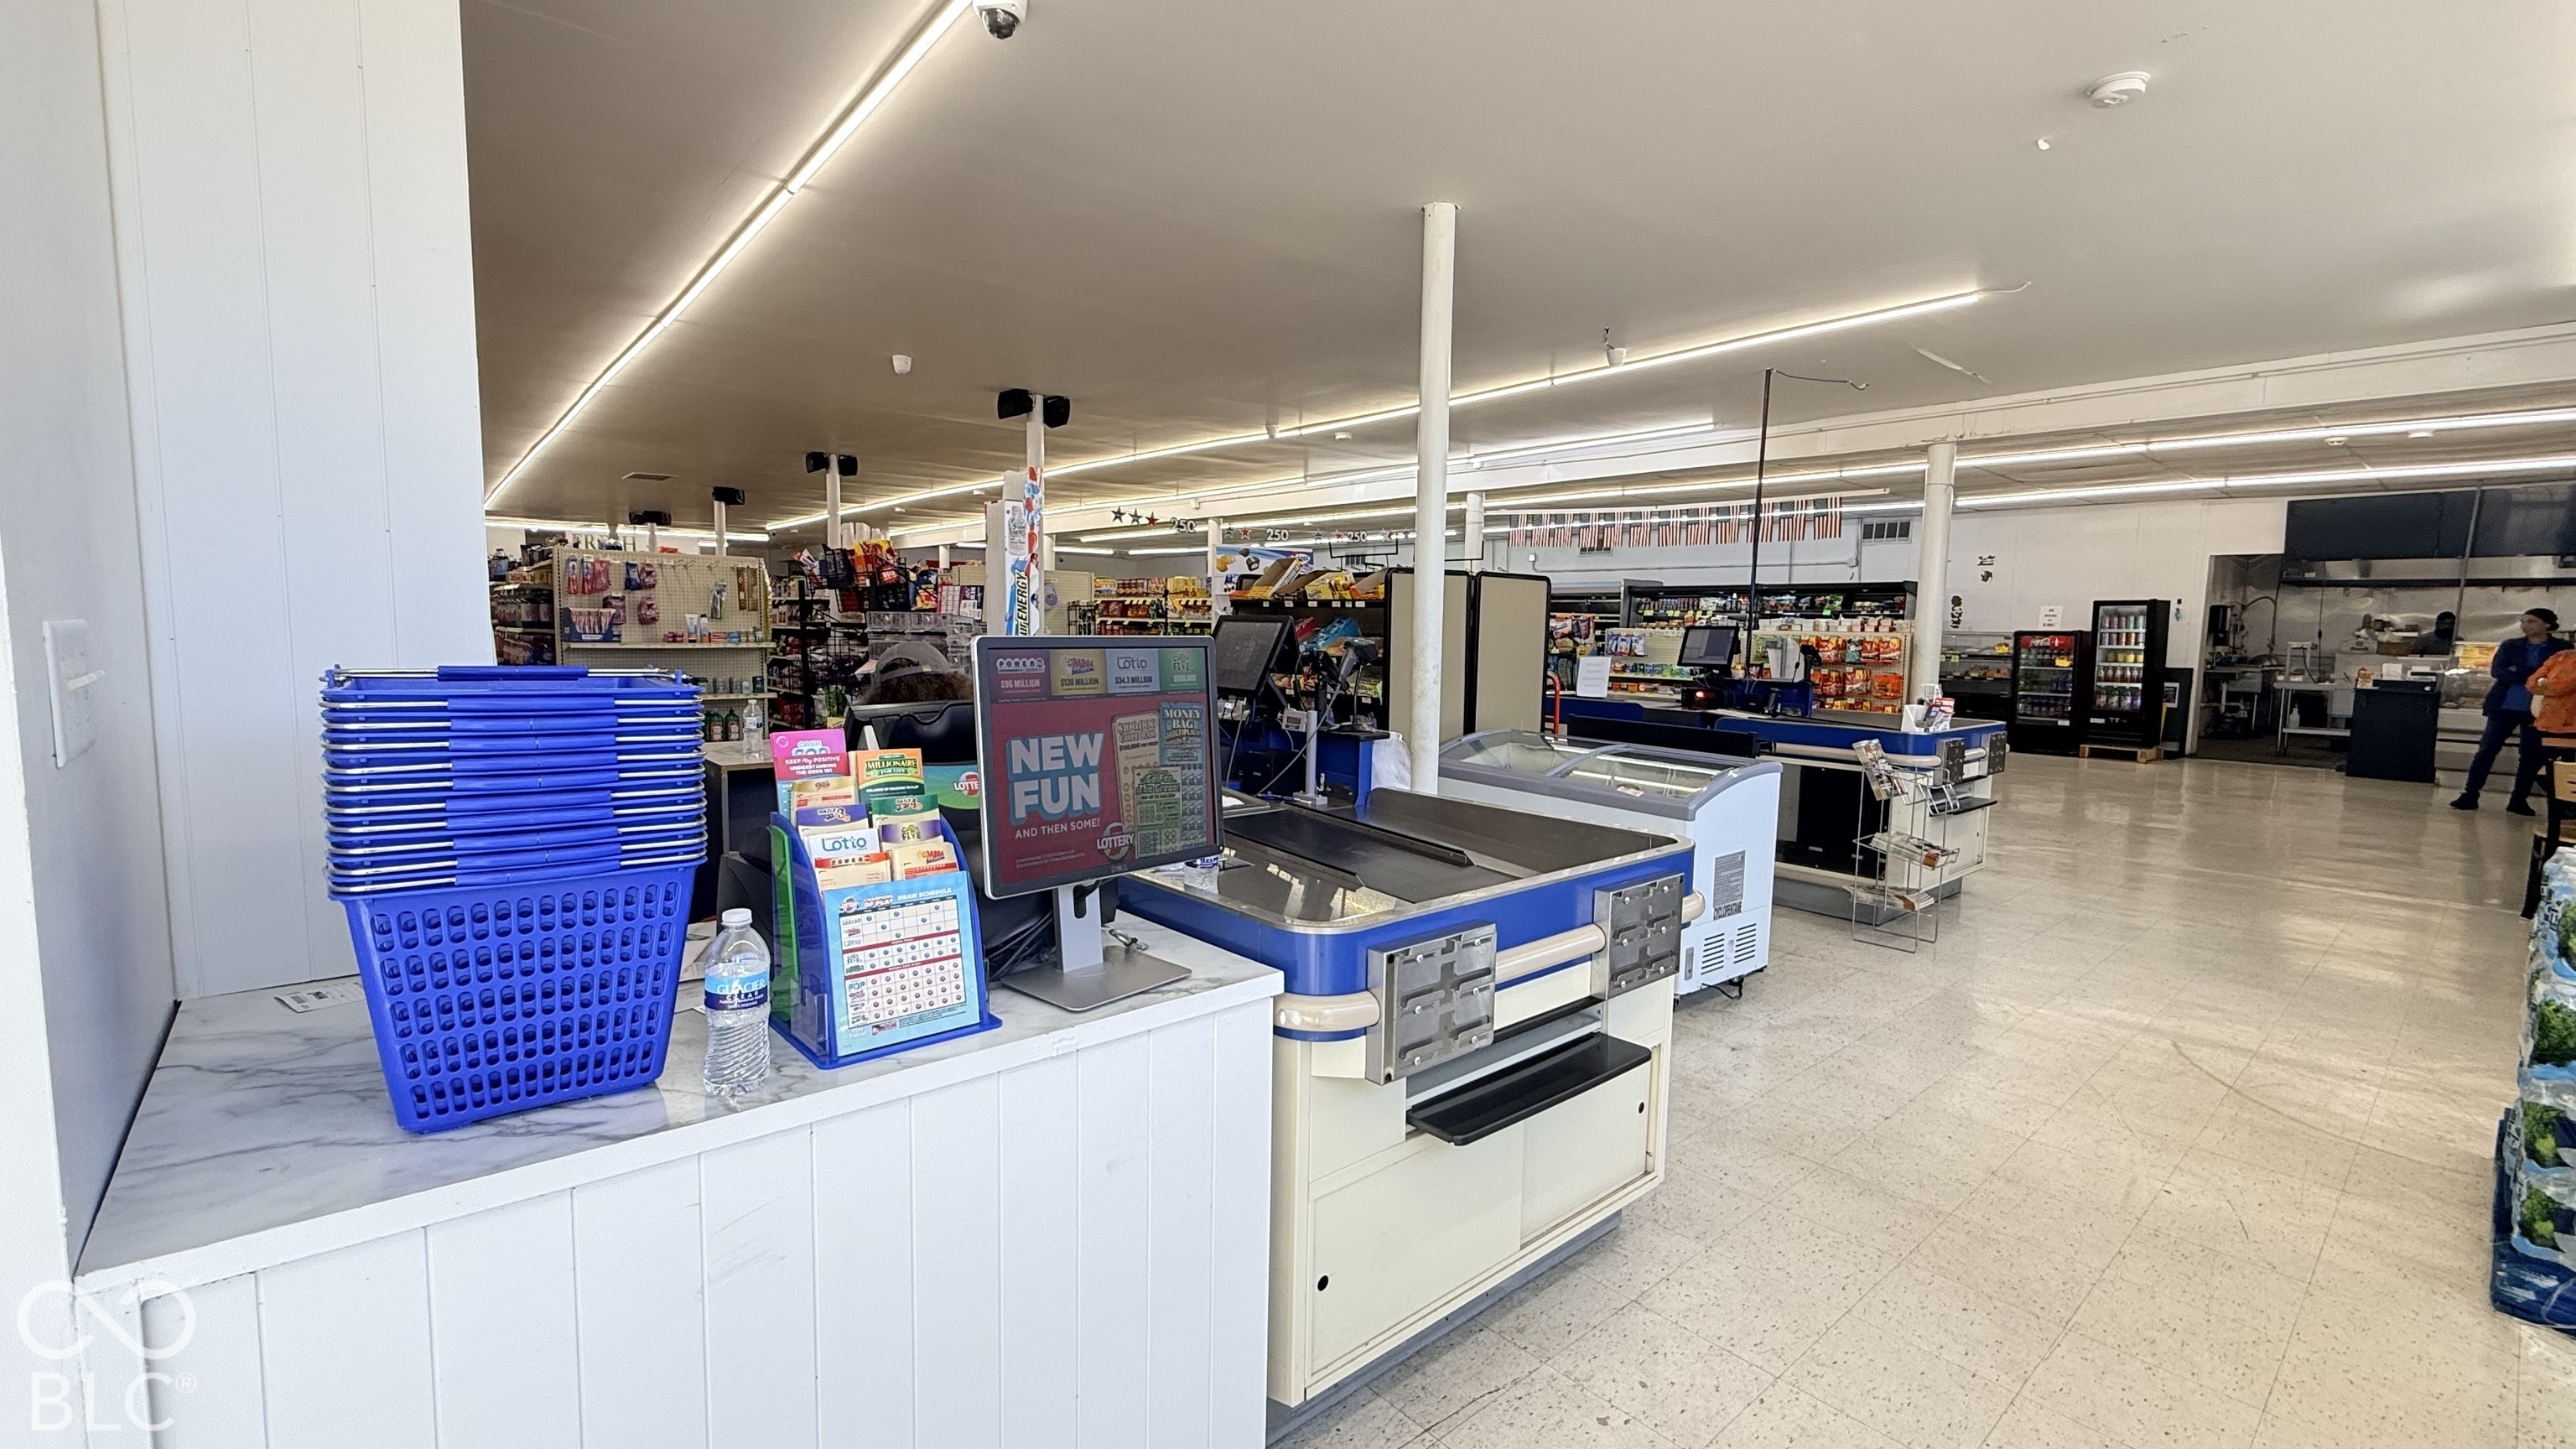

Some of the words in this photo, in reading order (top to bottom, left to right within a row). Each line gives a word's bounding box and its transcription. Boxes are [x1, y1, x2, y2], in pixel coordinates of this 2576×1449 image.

[1170, 517, 1196, 533] 250
[1265, 528, 1290, 541] 250
[1347, 531, 1368, 543] 250
[572, 533, 637, 552] FRH
[1016, 572, 1027, 621] ENERGY
[998, 659, 1036, 668] POWER
[1014, 679, 1040, 688] MILLION
[1061, 678, 1074, 687] $130
[1075, 678, 1098, 686] MILLION
[1115, 676, 1130, 684] $34.3
[1163, 709, 1202, 719] MONEY
[1172, 719, 1195, 729] BAG
[1011, 733, 1104, 774] NEW
[867, 758, 917, 770] MILLIONAIRE
[953, 782, 979, 791] LOTTE
[1014, 773, 1100, 818] FUN
[911, 798, 917, 808] 4
[837, 808, 844, 818] 3
[1015, 828, 1037, 839] AND
[1041, 822, 1067, 834] THEN
[1071, 818, 1100, 831] SOME!
[901, 831, 921, 840] FIVE
[1097, 833, 1135, 849] LOTTERY
[832, 856, 863, 865] POWER
[898, 892, 918, 901] DRAW
[919, 888, 952, 897] SCHEDULE
[717, 979, 765, 995] GLACIER
